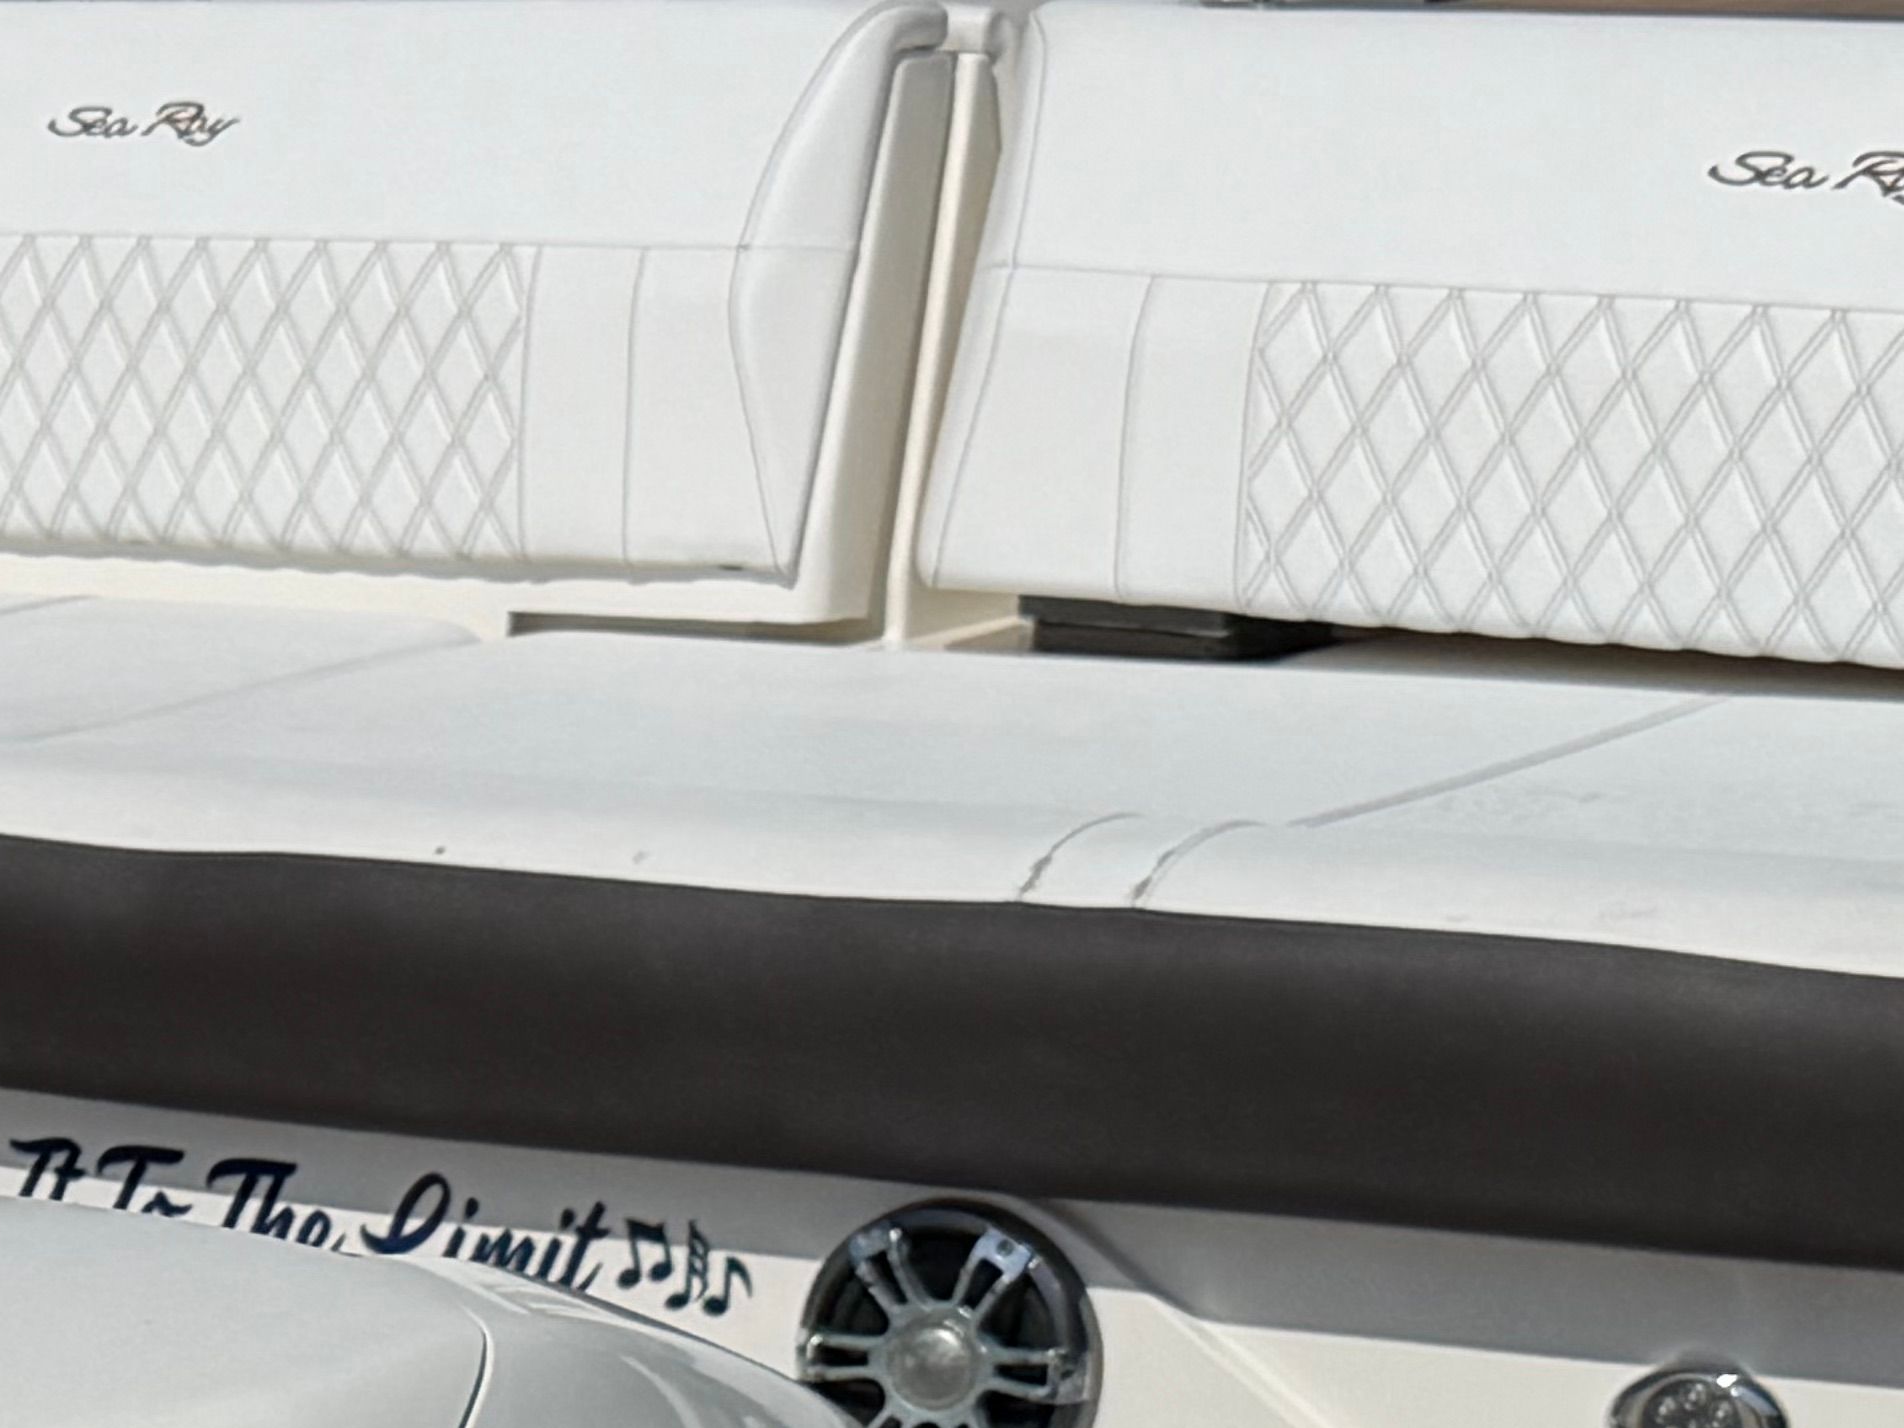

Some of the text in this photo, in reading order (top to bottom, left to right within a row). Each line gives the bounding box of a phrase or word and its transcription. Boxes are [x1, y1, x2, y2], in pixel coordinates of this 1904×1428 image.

[47, 100, 241, 147] Sea Ray
[1706, 149, 1830, 190] Sea
[9, 1137, 87, 1202] It
